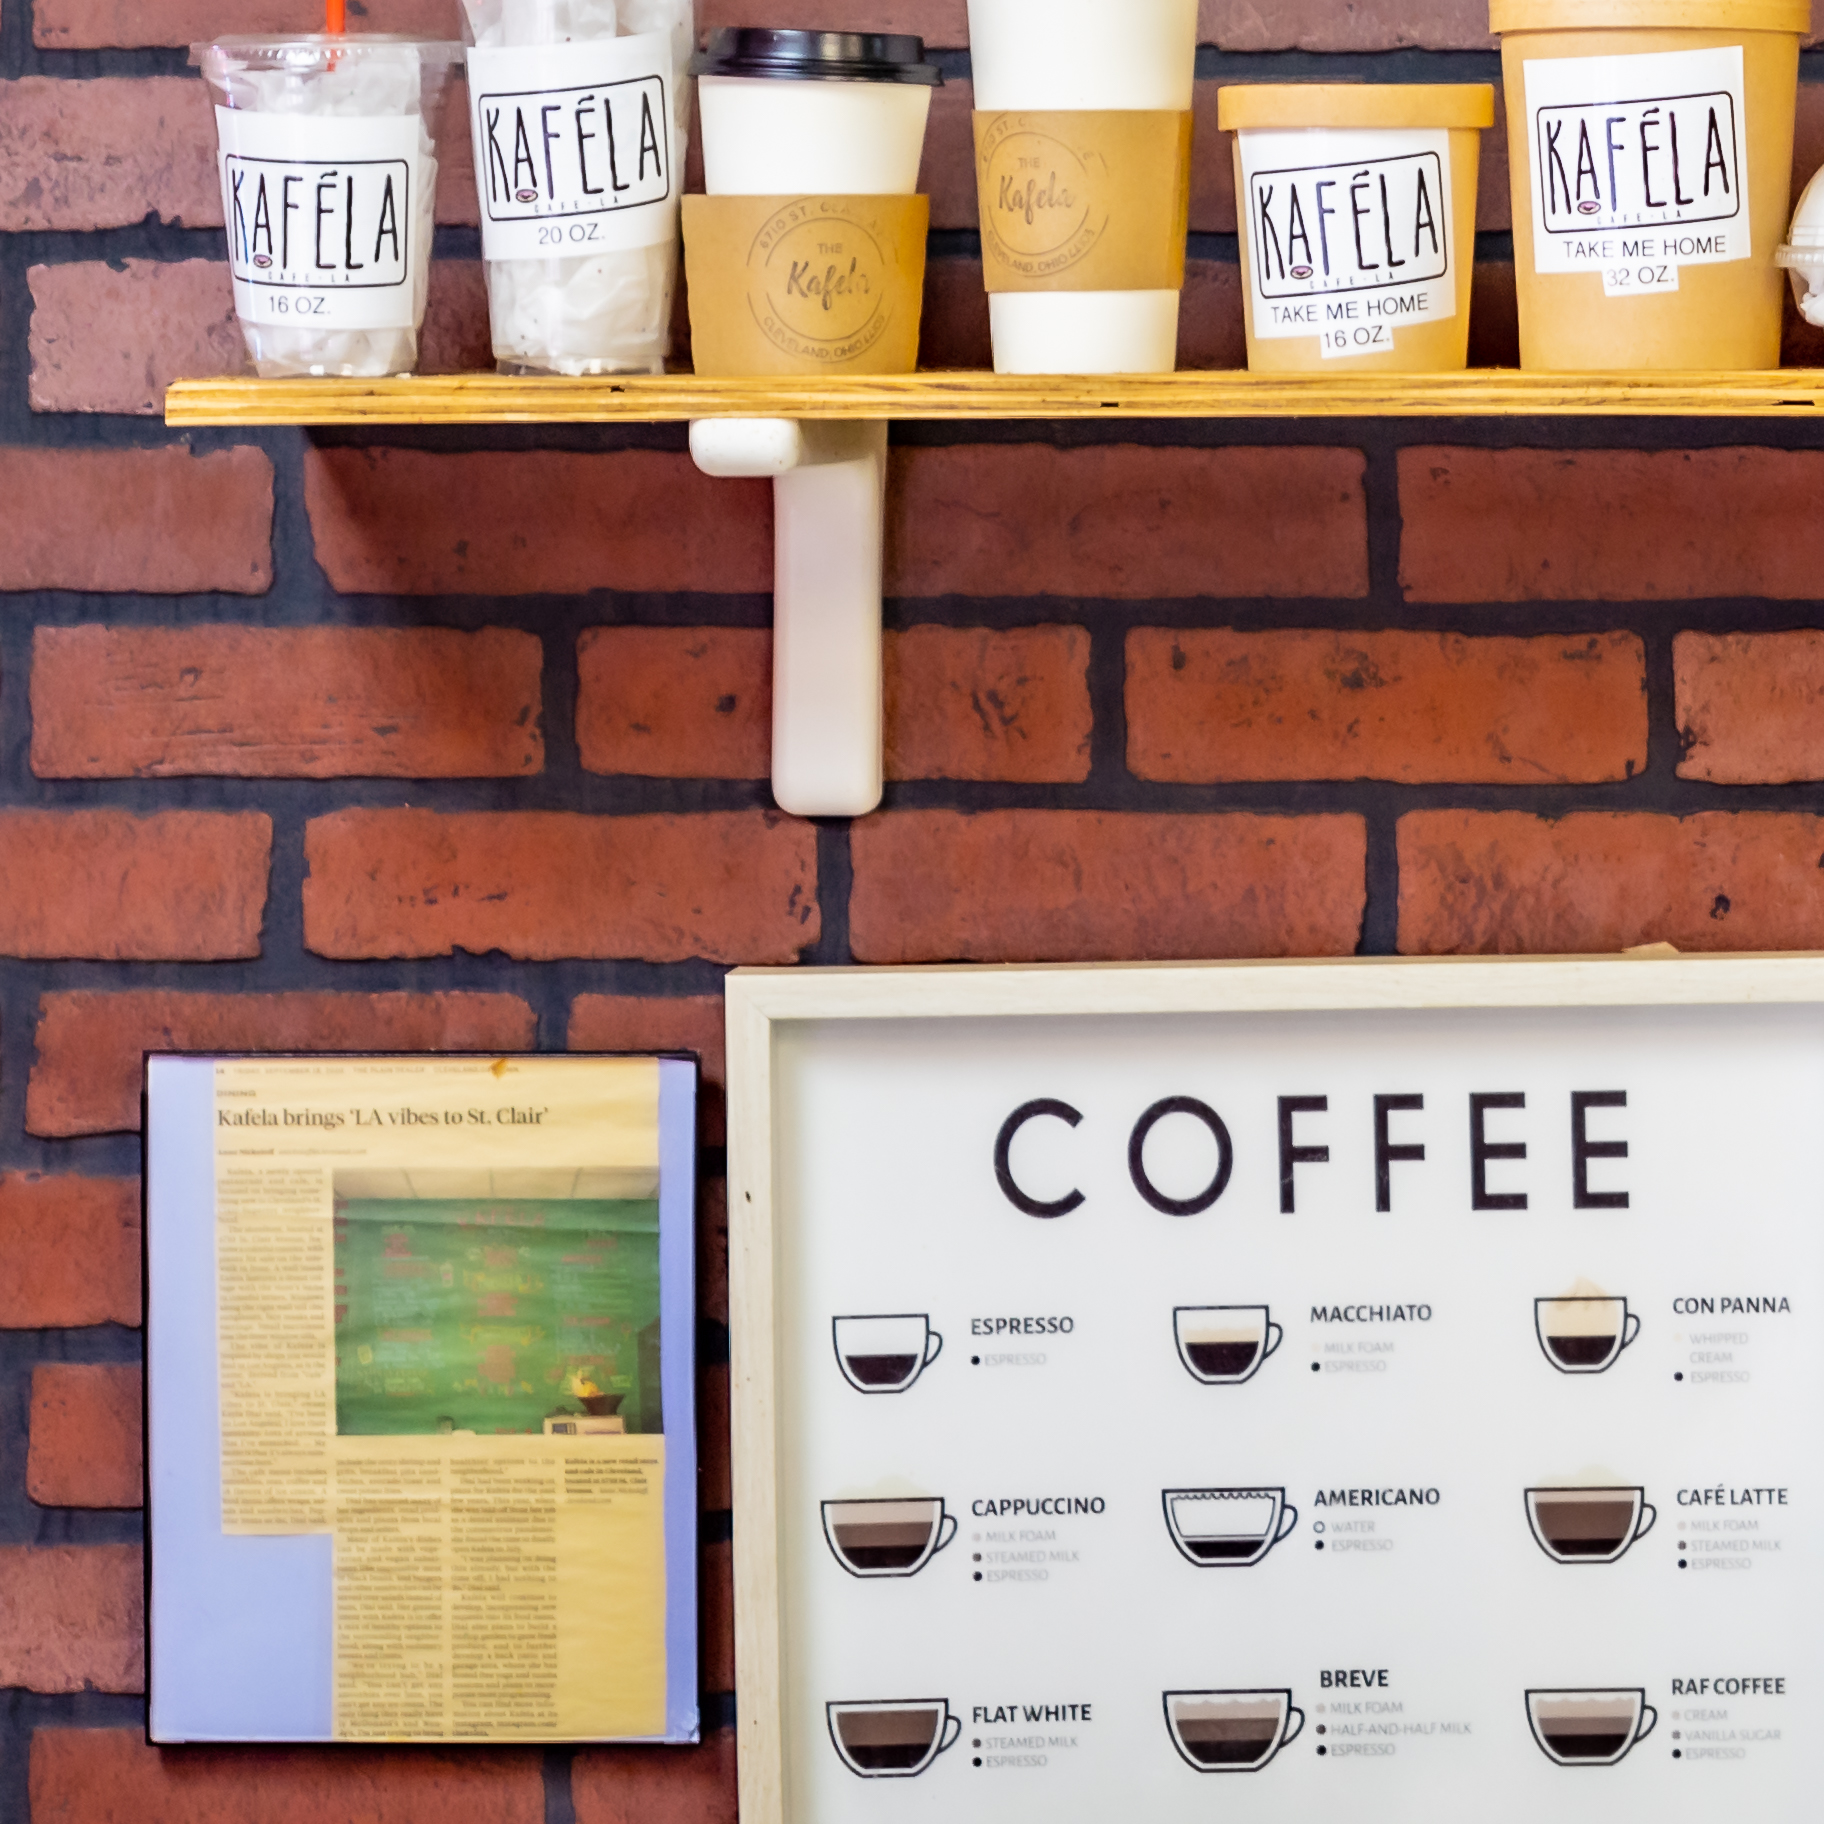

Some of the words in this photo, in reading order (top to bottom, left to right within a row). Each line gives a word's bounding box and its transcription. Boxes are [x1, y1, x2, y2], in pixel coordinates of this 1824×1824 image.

[487, 91, 662, 203] KAFÉLA
[1018, 157, 1040, 168] THE
[1546, 106, 1730, 216] KAFÉLA
[999, 170, 1076, 225] Kafela
[232, 169, 399, 270] KAFÉLA
[1259, 167, 1439, 280] KAFÉLA
[538, 225, 562, 245] 20
[569, 222, 605, 242] OZ.
[817, 243, 842, 254] THE
[1563, 241, 1614, 258] TAKE
[1622, 239, 1655, 257] ME
[1663, 235, 1727, 256] HOME
[1606, 268, 1631, 287] 32
[1637, 265, 1675, 284] OZ.
[269, 295, 289, 314] 16
[295, 296, 331, 315] OZ.
[1271, 304, 1318, 324] TAKE
[1326, 300, 1359, 320] ME
[1367, 292, 1429, 318] HOME
[1323, 330, 1347, 349] 16
[1353, 325, 1390, 346] OZ.
[218, 1107, 278, 1127] Kafela
[283, 1107, 345, 1130] brings
[388, 1107, 439, 1126] vibes
[444, 1109, 463, 1125] to
[467, 1107, 492, 1125] St.
[993, 1089, 1630, 1219] COFFEE
[1673, 1297, 1714, 1314] CON
[1720, 1296, 1791, 1314] PANNA
[1310, 1304, 1432, 1323] MACCHIATO
[971, 1316, 1074, 1335] ESPRESSO
[1689, 1332, 1749, 1345] WHIPPED
[1324, 1342, 1354, 1354] MILK
[1358, 1341, 1394, 1353] FOAM
[984, 1353, 1047, 1366] ESPRESSO
[1689, 1351, 1733, 1364] CREAM
[1324, 1359, 1387, 1373] ESPRESSO
[1690, 1370, 1750, 1384] ESPRESSO
[1314, 1487, 1440, 1507] AMERICANO
[1677, 1482, 1725, 1506] CAFÉ
[1730, 1488, 1788, 1505] LATTE
[972, 1496, 1106, 1517] CAPPUCCINO
[1331, 1520, 1375, 1533] WATER
[1690, 1520, 1720, 1531] MILK
[1723, 1520, 1758, 1531] FOAM
[985, 1531, 1016, 1542] MILK
[1020, 1530, 1056, 1542] FOAM
[1331, 1539, 1393, 1552] ESPRESSO
[1690, 1539, 1749, 1552] STEAMED
[1752, 1539, 1781, 1551] MILK
[986, 1550, 1047, 1564] STEAMED
[1049, 1550, 1080, 1562] MILK
[1691, 1558, 1752, 1570] ESPRESSO
[986, 1569, 1049, 1582] ESPRESSO
[1320, 1669, 1389, 1688] BREVE
[1672, 1678, 1710, 1695] RAF
[1713, 1677, 1786, 1695] COFFEE
[972, 1705, 1018, 1724] FLAT
[1022, 1703, 1092, 1722] WHITE
[1330, 1702, 1362, 1714] MILK
[1365, 1701, 1403, 1713] FOAM
[1684, 1709, 1728, 1721] CREAM
[1331, 1722, 1436, 1736] HALF-AND-HALF
[1440, 1722, 1472, 1735] MILK
[1685, 1730, 1736, 1742] VANILLA
[1740, 1729, 1781, 1741] SUGAR
[986, 1736, 1045, 1749] STEAMED
[1048, 1736, 1078, 1748] MILK
[1331, 1743, 1395, 1756] ESPRESSO
[986, 1755, 1047, 1768] ESPRESSO
[1685, 1748, 1745, 1761] ESPRESSO
